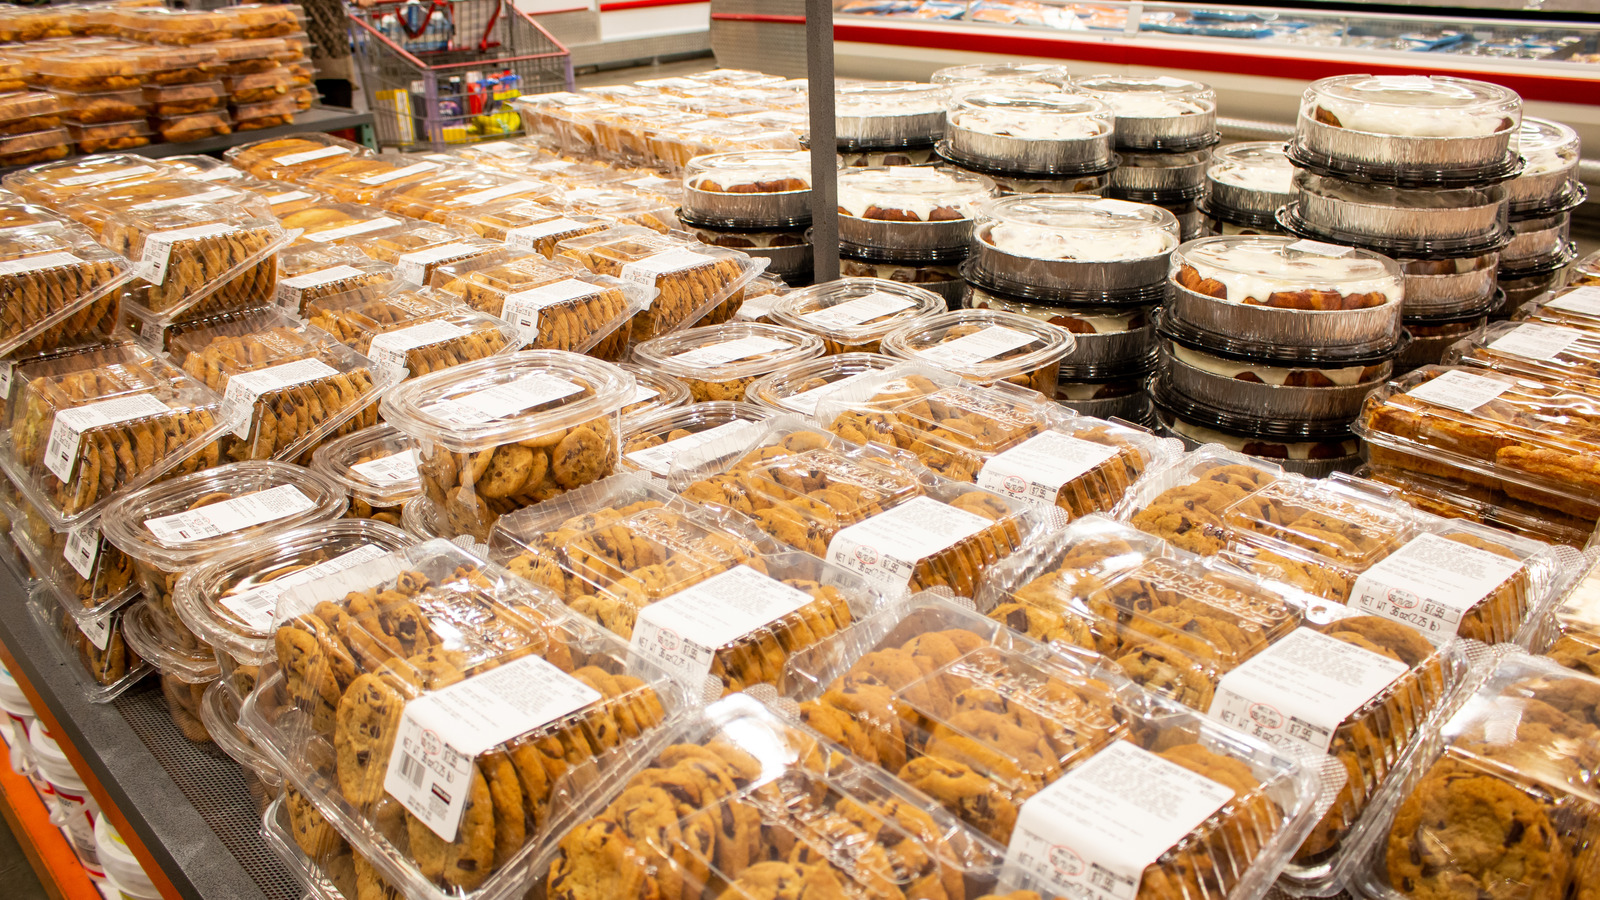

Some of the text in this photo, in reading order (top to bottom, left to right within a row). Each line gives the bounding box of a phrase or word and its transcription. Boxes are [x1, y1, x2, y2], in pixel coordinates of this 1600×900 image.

[835, 552, 846, 563] NET
[1360, 594, 1374, 606] NET
[1376, 600, 1387, 612] WT
[1389, 605, 1400, 617] 36
[1424, 603, 1446, 619] $7.99
[1220, 709, 1236, 723] NET
[1289, 723, 1312, 742] $7.99
